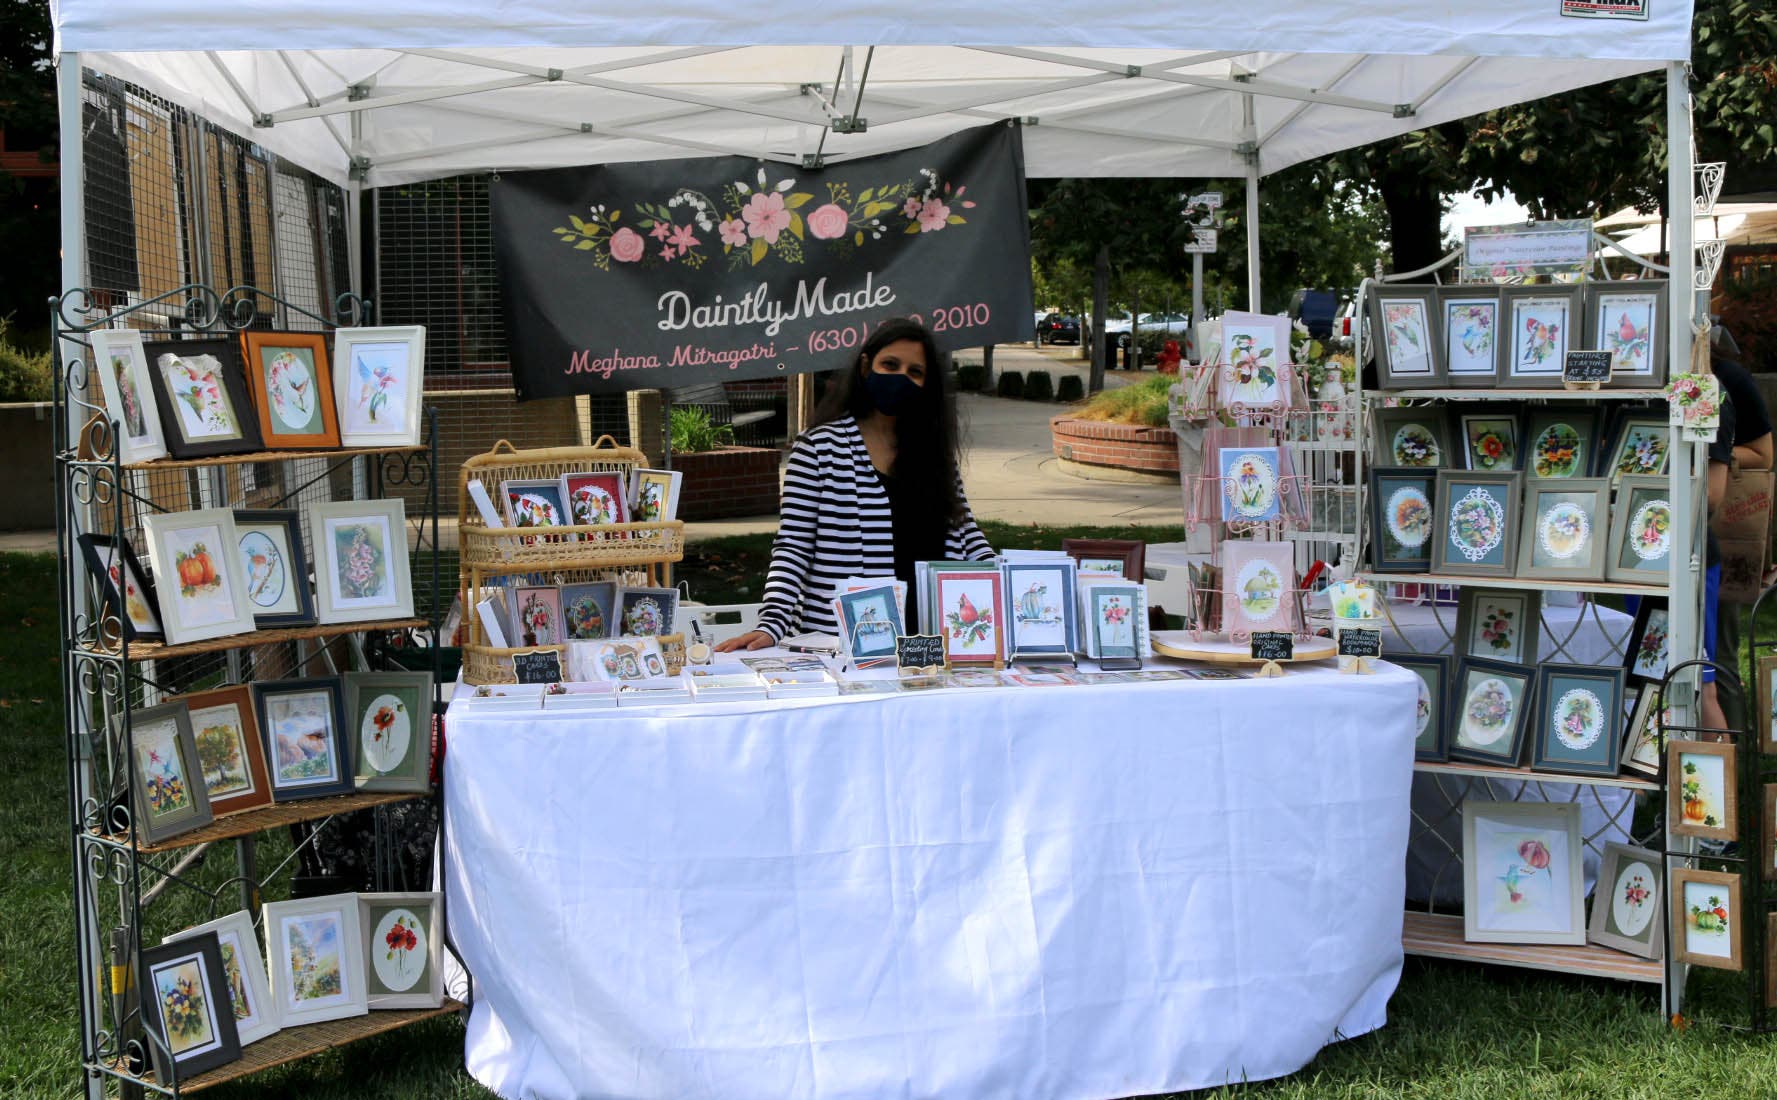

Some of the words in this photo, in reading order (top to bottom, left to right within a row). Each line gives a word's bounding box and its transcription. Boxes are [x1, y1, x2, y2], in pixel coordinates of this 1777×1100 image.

[565, 348, 660, 379] Meghana
[667, 341, 776, 369] Mitragotri
[808, 321, 869, 355] (630)
[932, 303, 991, 332] 2010
[1568, 359, 1608, 367] STARTING
[1253, 632, 1271, 640] HAND
[903, 638, 940, 647] PRINTED
